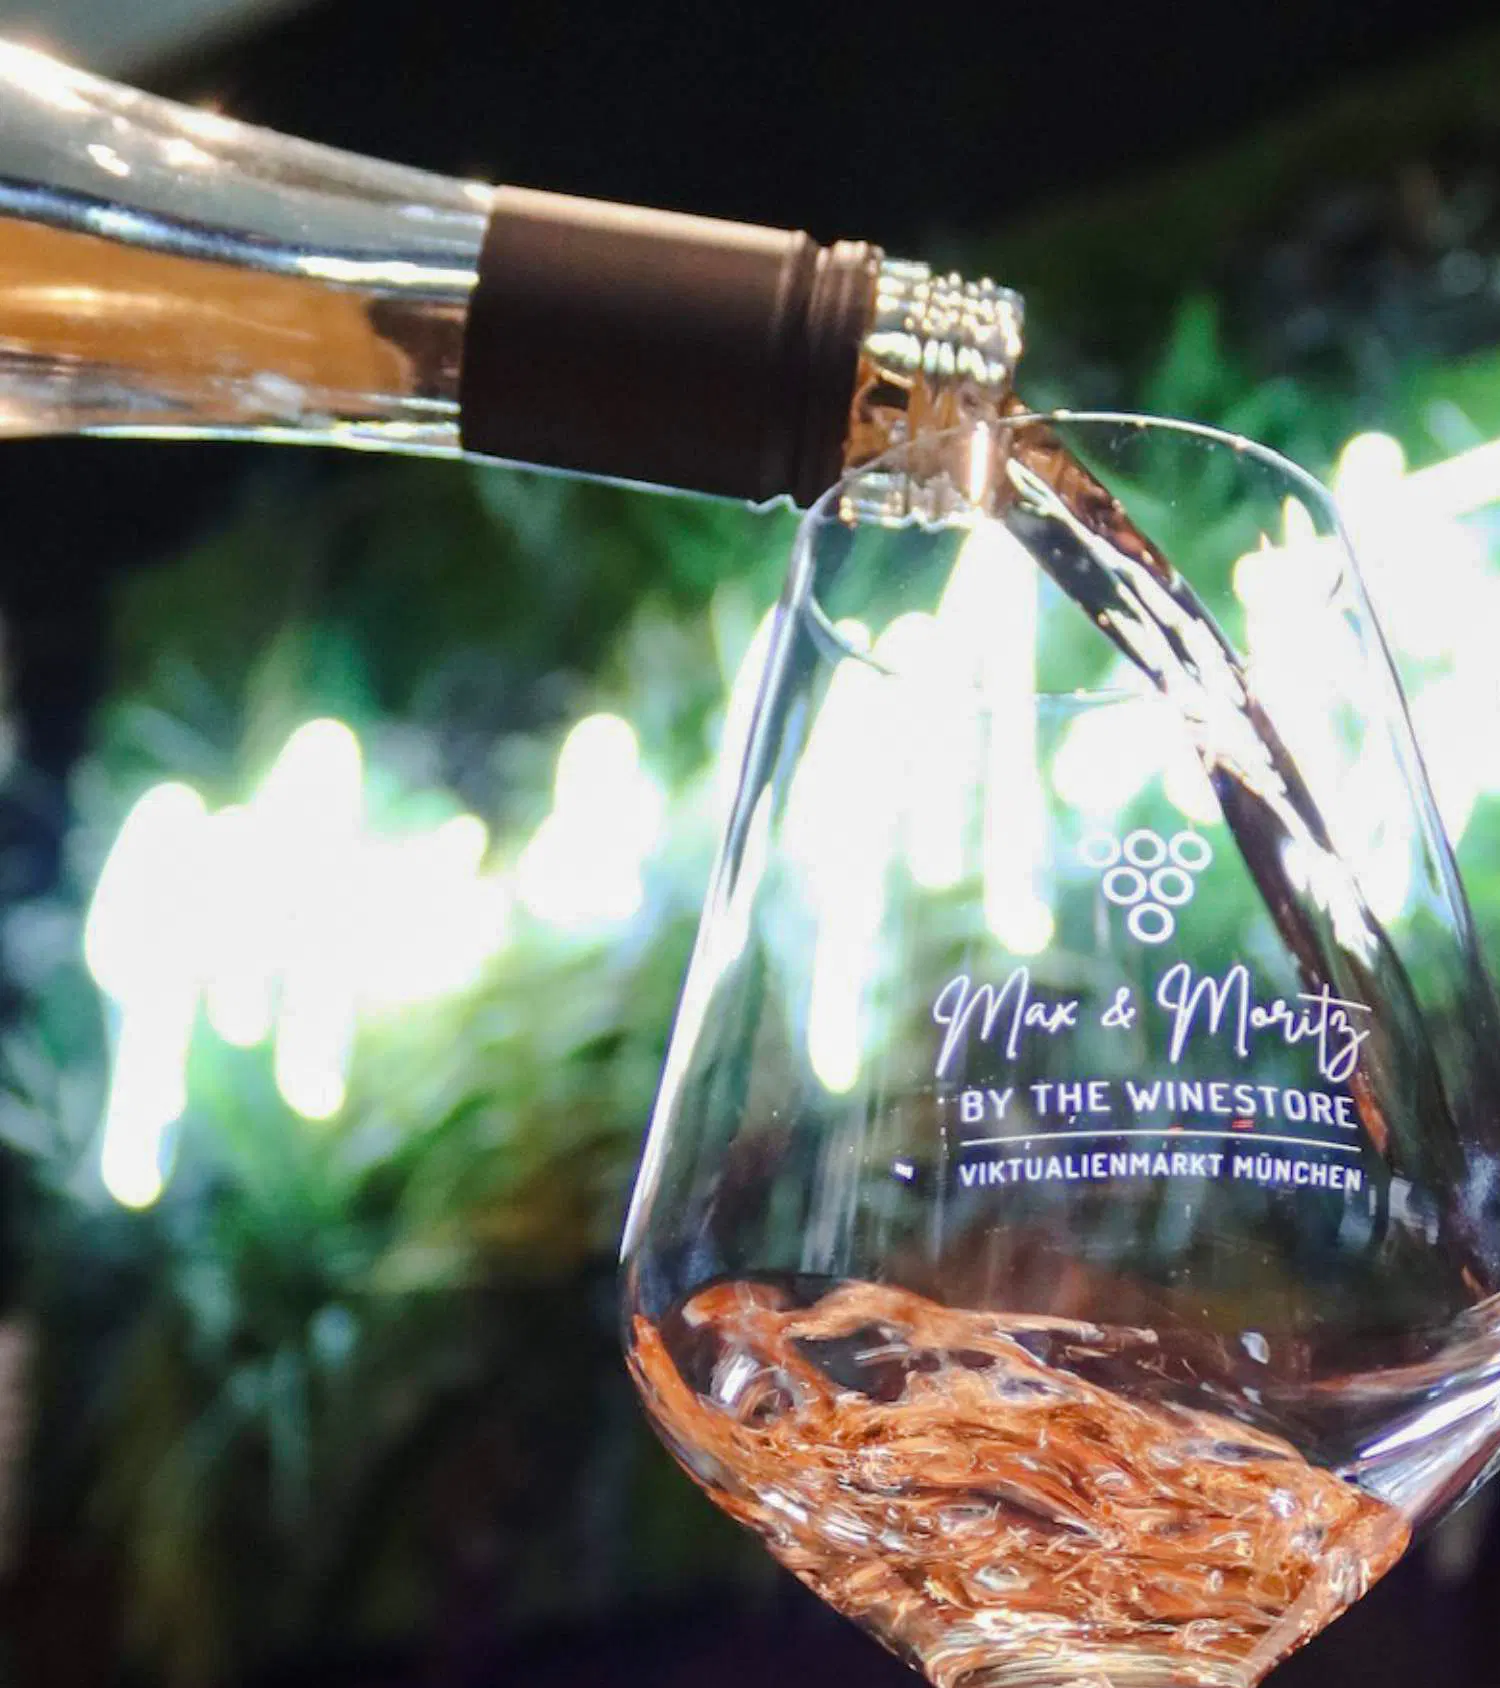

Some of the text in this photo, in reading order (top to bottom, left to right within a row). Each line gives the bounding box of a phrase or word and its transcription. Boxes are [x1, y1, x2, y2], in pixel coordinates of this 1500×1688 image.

[933, 962, 1373, 1083] Max & Moritz
[959, 1080, 1359, 1130] BY THE WINESTORE
[959, 1151, 1363, 1192] VIKTUALIENMARKT MÜNCHEN
